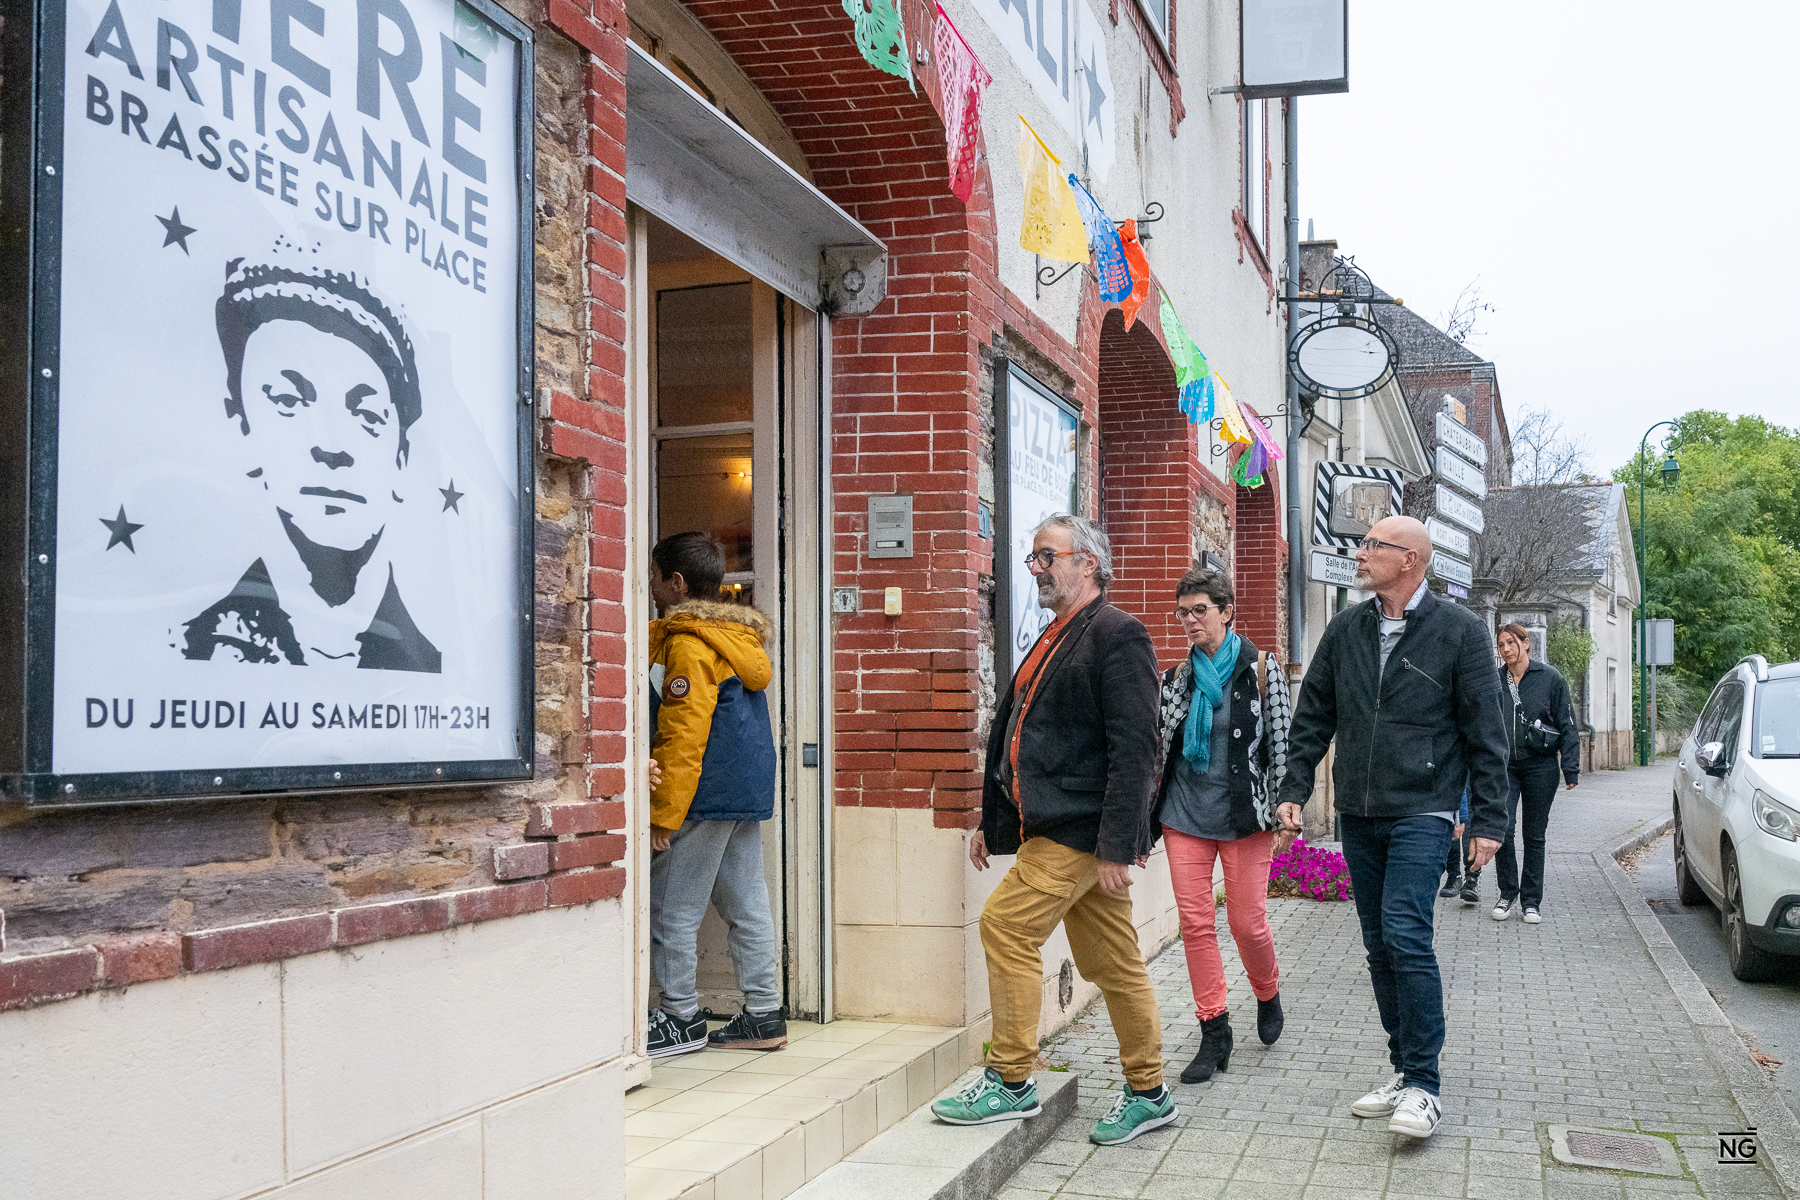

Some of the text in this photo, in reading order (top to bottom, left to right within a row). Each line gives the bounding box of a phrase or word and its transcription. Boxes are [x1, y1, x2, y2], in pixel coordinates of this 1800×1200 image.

[85, 0, 488, 249] ARTISANALE
[86, 73, 487, 294] BRASSÉE SUR PLACE
[1011, 389, 1068, 474] PIZZA
[1020, 475, 1037, 493] PLACE
[1024, 454, 1040, 480] FEU
[1041, 463, 1053, 486] DE
[1325, 556, 1340, 568] Salle
[1341, 560, 1348, 570] de
[1325, 569, 1353, 583] Complexe
[86, 697, 490, 729] DU JEUDI AU SAMEDI 17H-23H
